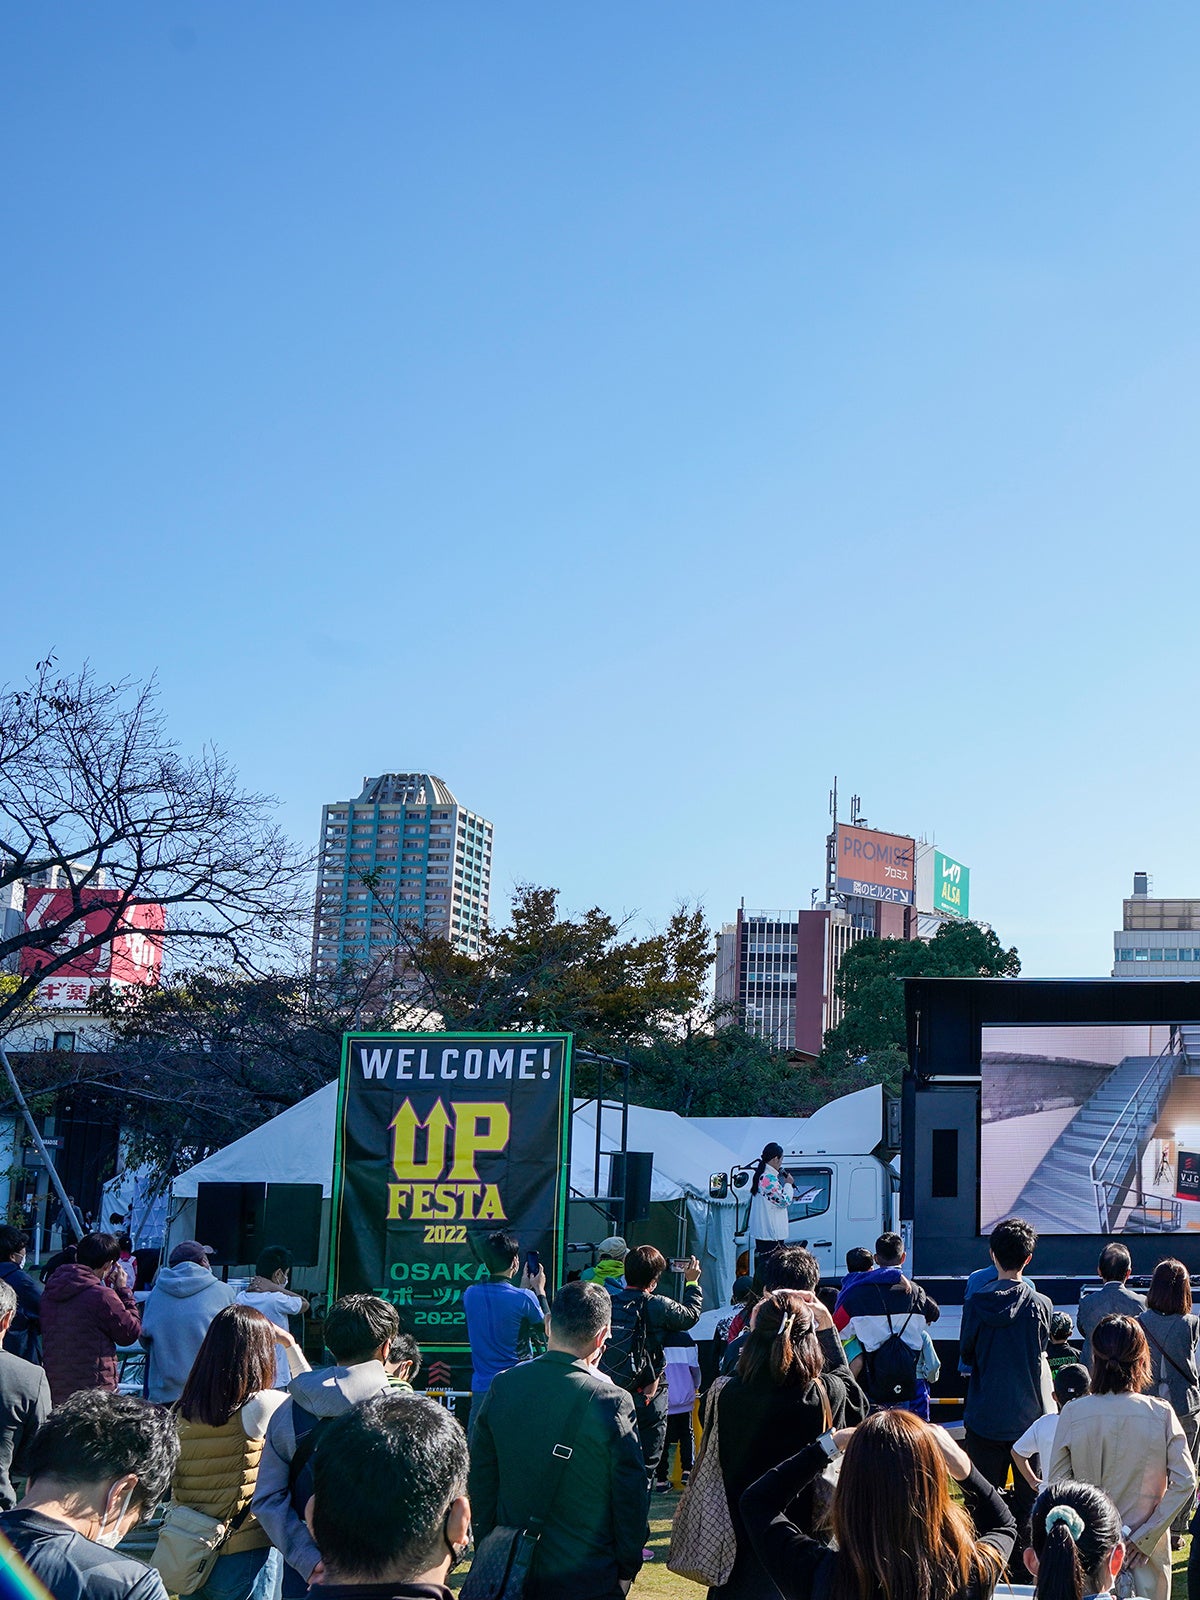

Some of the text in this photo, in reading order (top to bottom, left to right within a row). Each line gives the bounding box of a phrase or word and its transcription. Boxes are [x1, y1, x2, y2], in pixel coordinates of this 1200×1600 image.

[843, 836, 909, 868] PROMISE
[884, 866, 909, 881] プロミス
[942, 858, 961, 884] レイク
[941, 882, 961, 906] ALSA
[360, 1048, 551, 1080] WELCOME!
[387, 1096, 511, 1181] UP
[1180, 1173, 1200, 1183] VJC
[386, 1183, 508, 1220] FESTA
[423, 1225, 467, 1244] 2022
[390, 1262, 491, 1281] OSAKA
[414, 1311, 466, 1325] 2022
